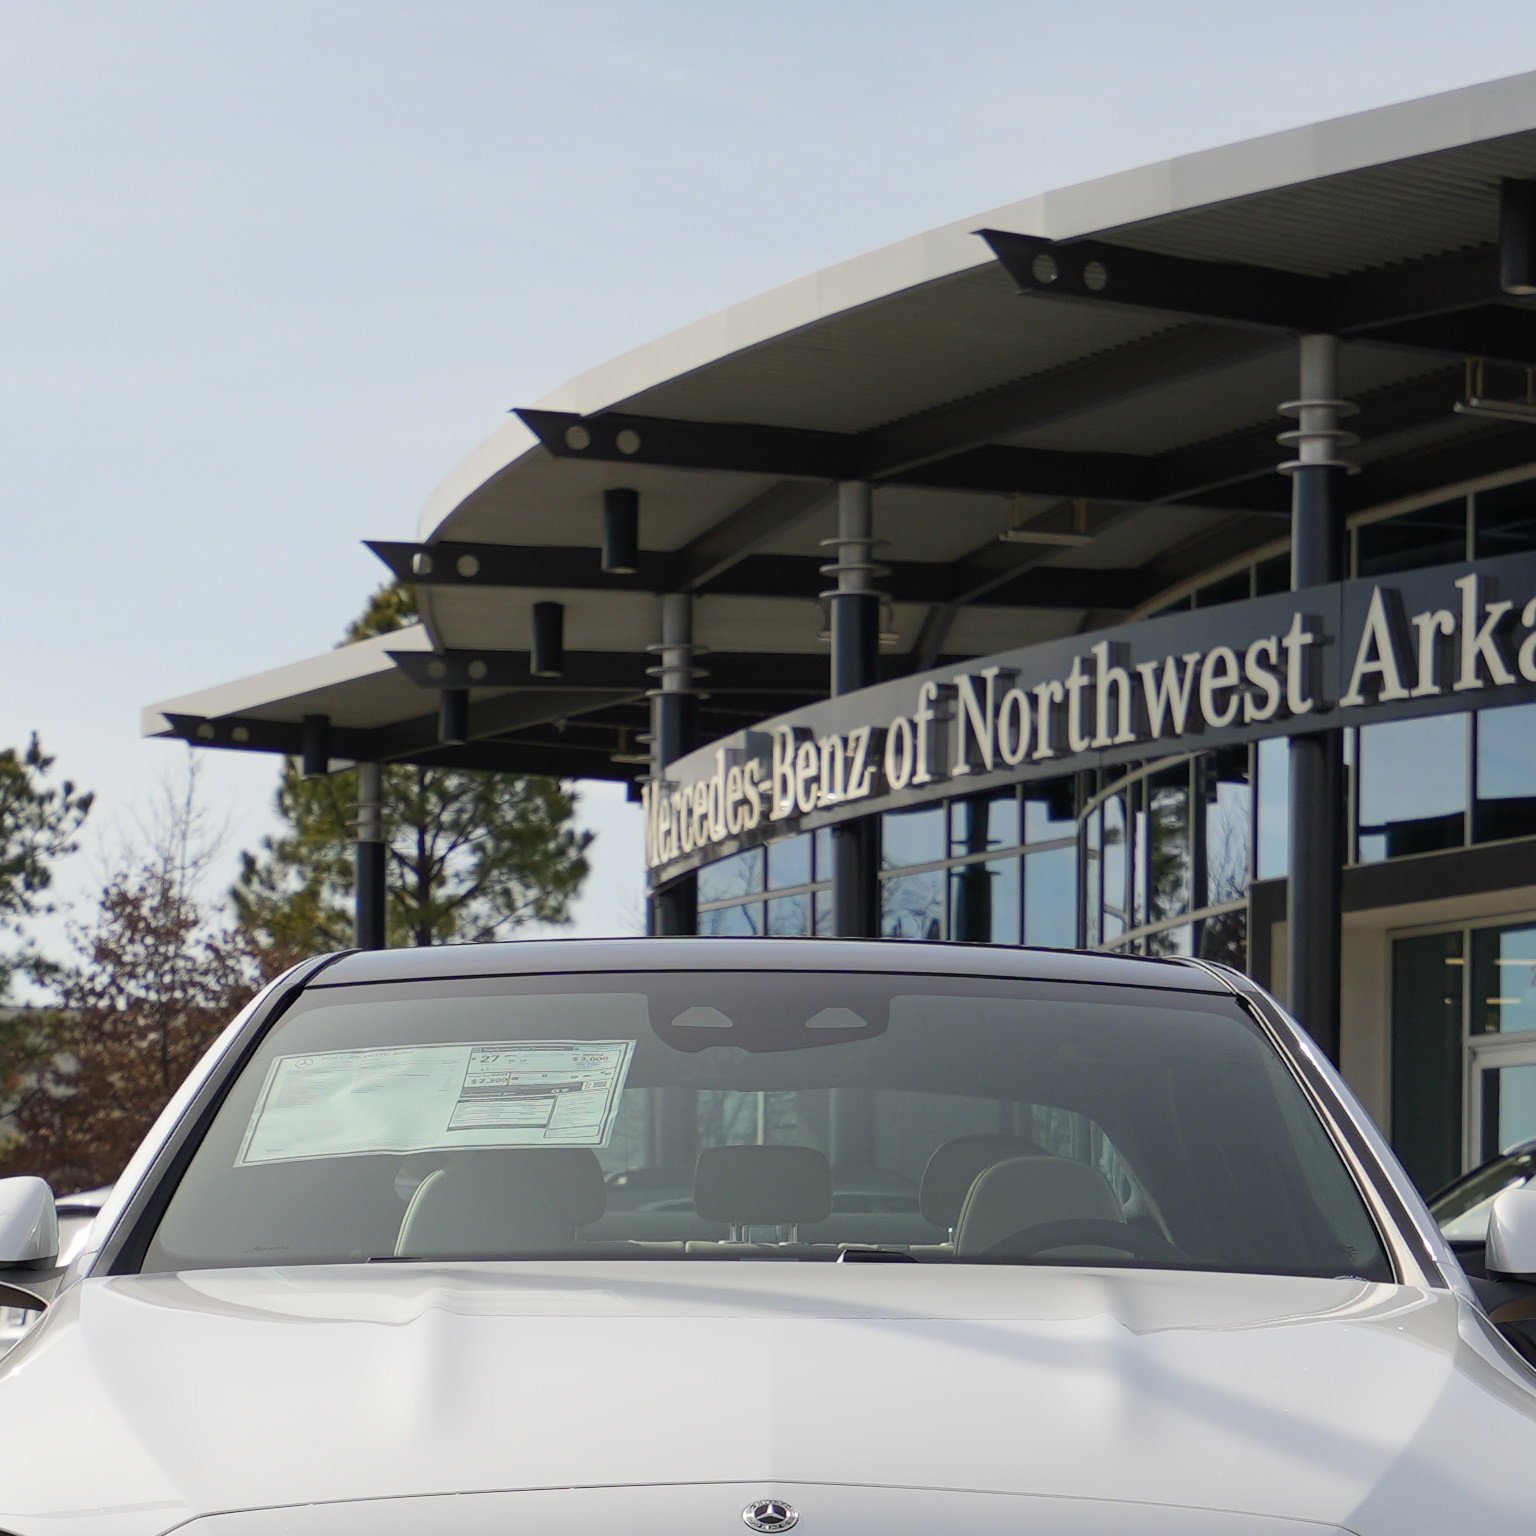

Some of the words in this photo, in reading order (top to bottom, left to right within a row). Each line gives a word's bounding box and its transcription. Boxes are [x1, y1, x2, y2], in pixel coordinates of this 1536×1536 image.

[642, 724, 875, 868] Mercedes-Benz
[884, 681, 937, 790] of
[952, 611, 1313, 771] Northwest
